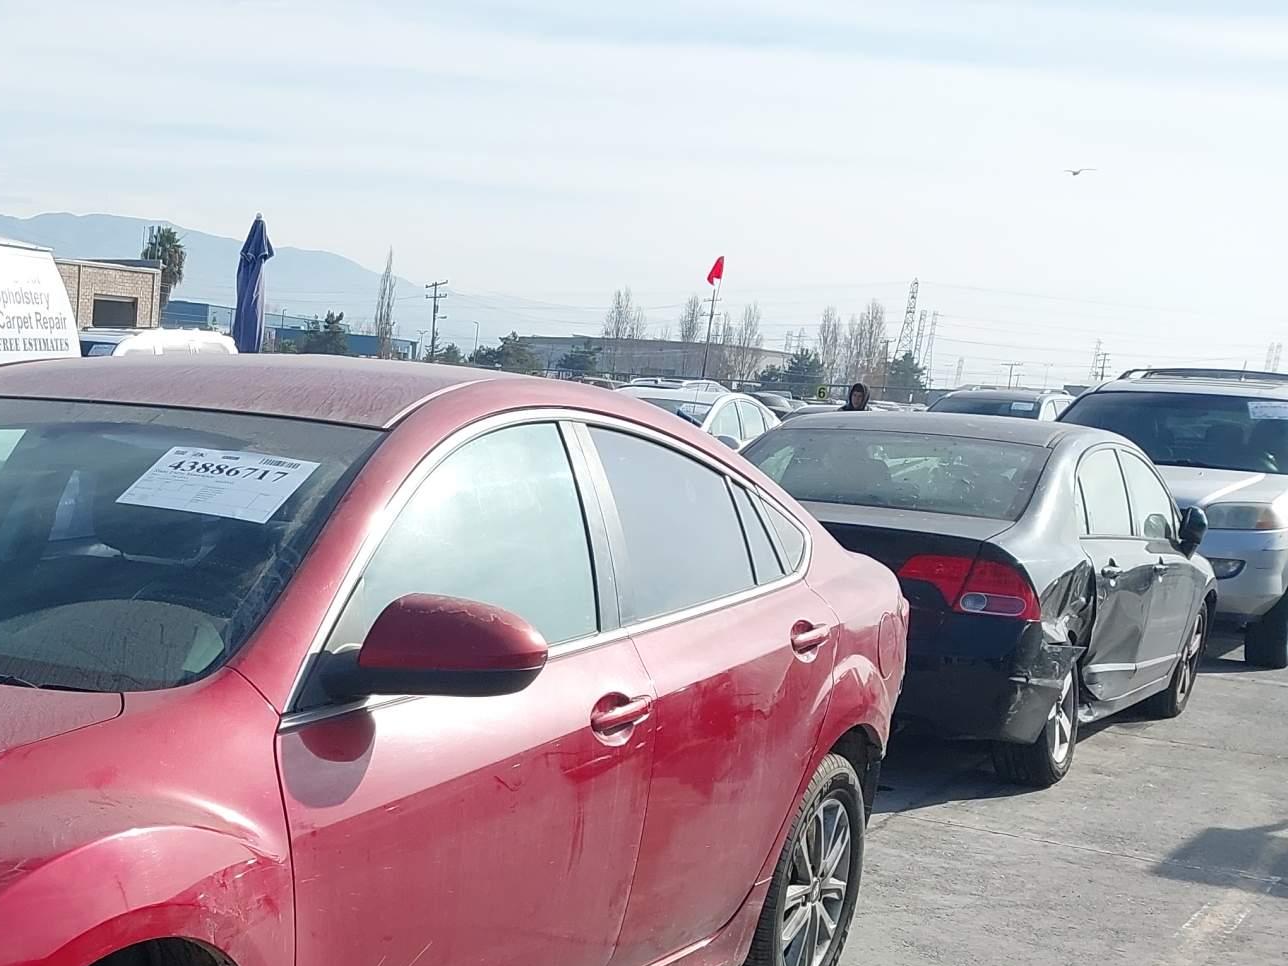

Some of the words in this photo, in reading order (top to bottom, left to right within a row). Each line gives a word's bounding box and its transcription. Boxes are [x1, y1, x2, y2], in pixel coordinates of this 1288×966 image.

[35, 311, 68, 334] Repair
[23, 337, 70, 352] ESTIMATES
[818, 387, 826, 399] 6
[168, 459, 289, 482] 43886717
